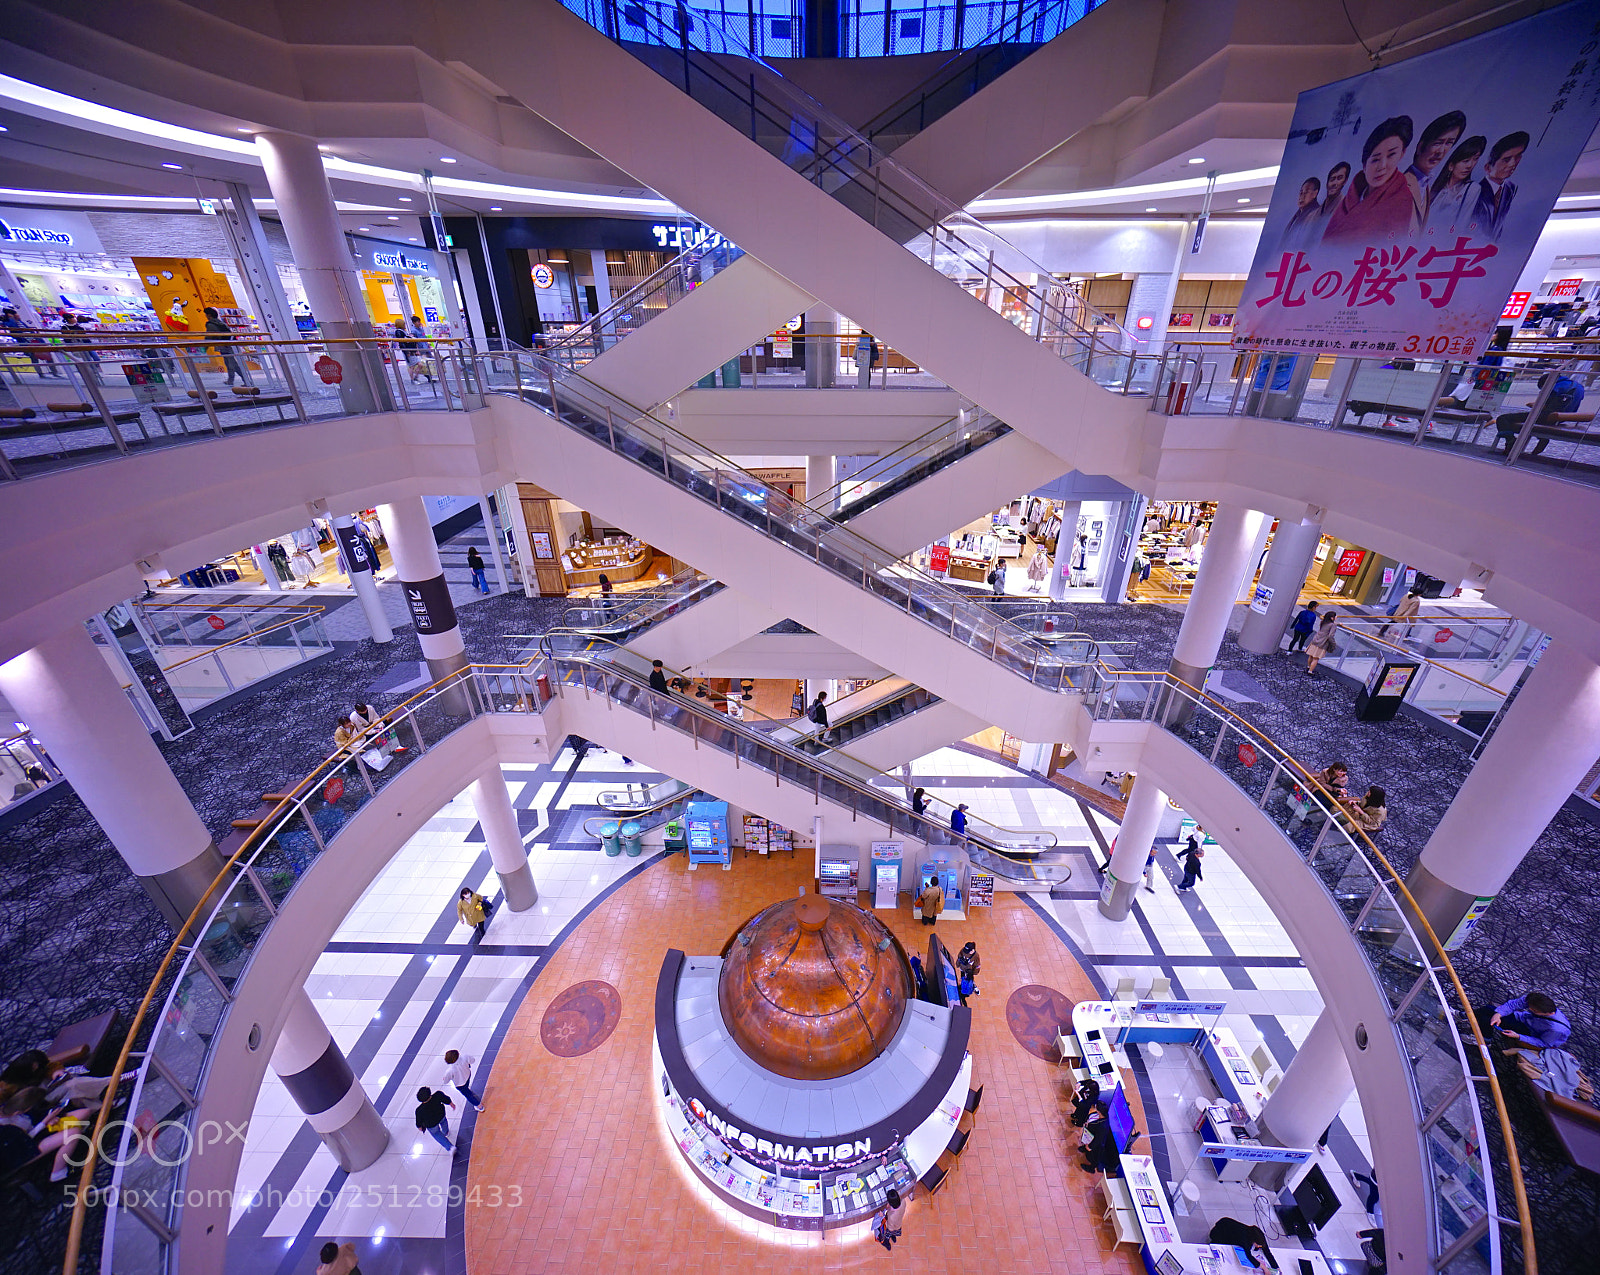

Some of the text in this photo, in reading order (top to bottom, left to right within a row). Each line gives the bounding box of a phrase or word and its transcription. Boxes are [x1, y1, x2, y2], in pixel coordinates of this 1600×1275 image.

[11, 227, 71, 246] TOWN Shop
[438, 234, 445, 247] 3
[1255, 236, 1499, 309] 北の桜守
[509, 541, 515, 552] 2
[931, 552, 949, 561] SALE
[705, 1109, 872, 1164] INFORMATION
